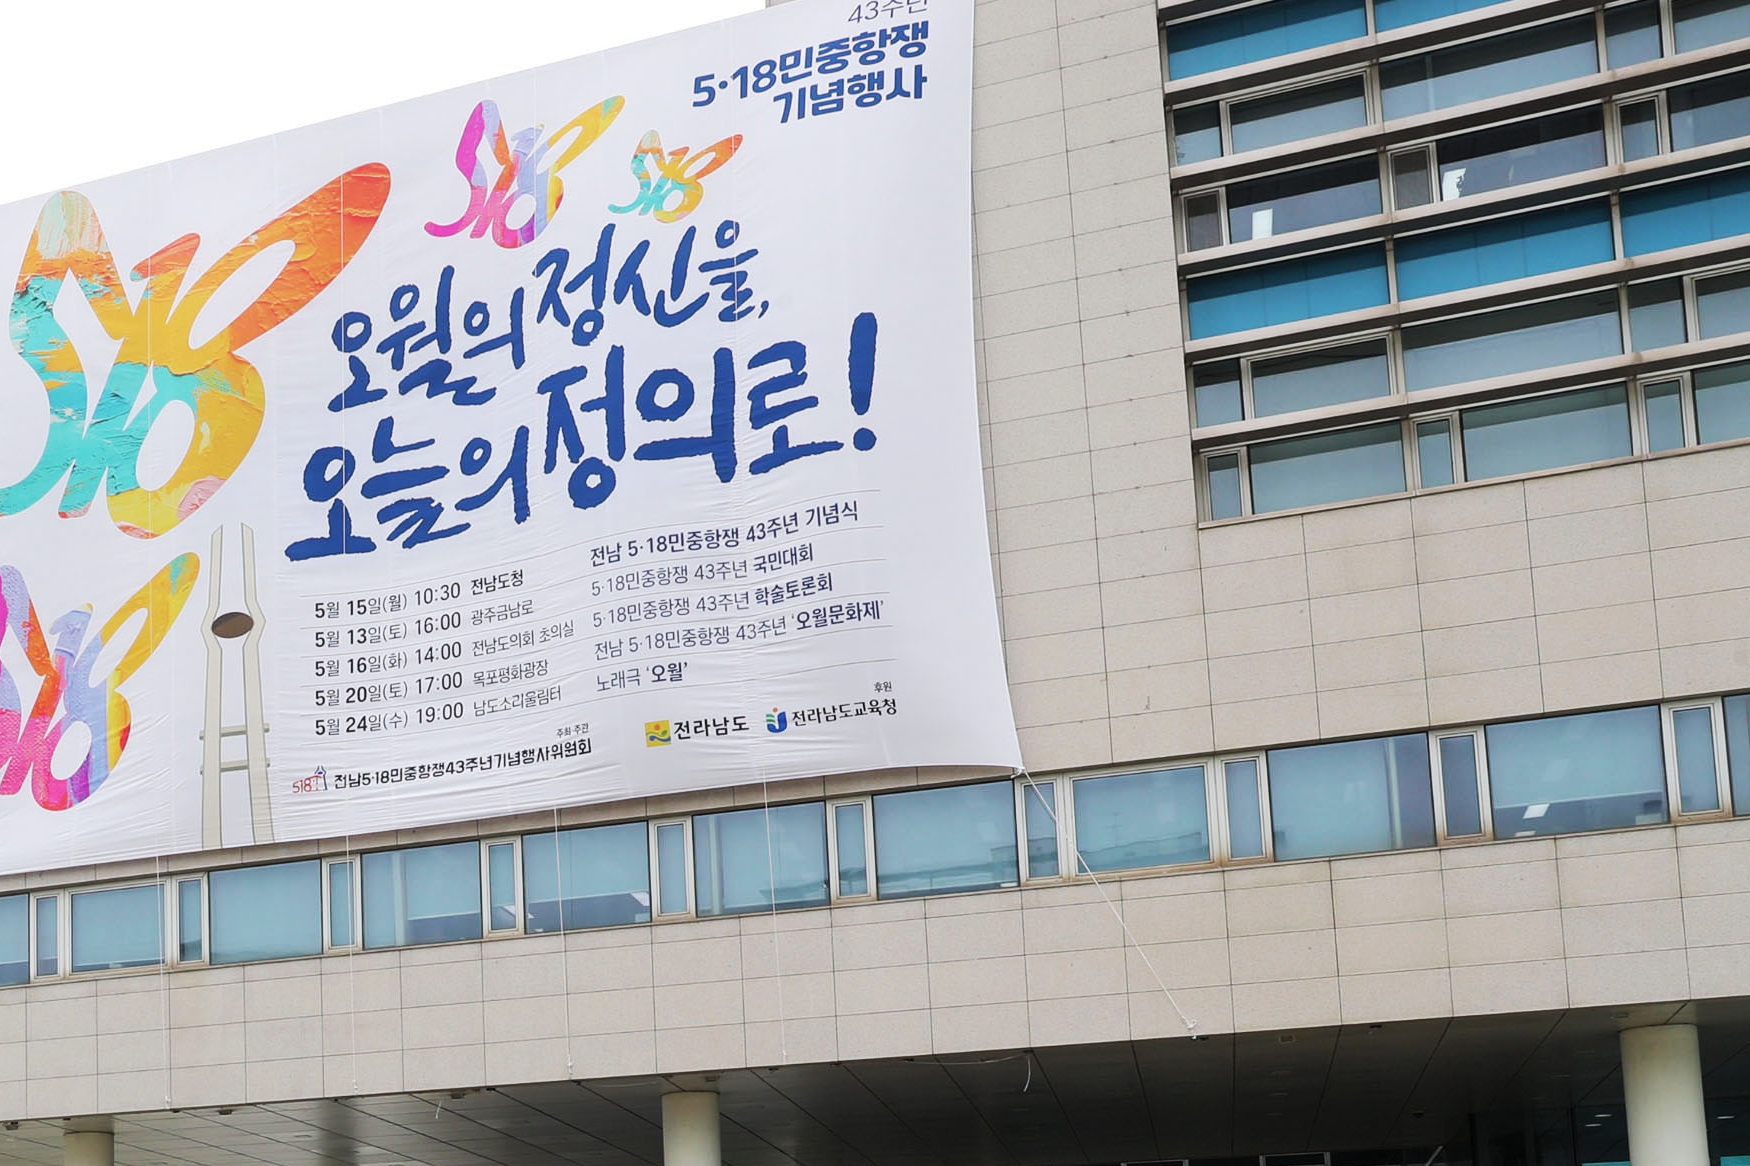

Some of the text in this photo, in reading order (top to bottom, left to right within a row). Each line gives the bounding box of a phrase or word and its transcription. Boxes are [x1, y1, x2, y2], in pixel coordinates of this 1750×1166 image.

[693, 20, 929, 107] 5·18민중항쟁
[773, 64, 928, 123] 기념행사
[328, 220, 769, 413] 오월의 정신을,
[284, 312, 878, 561] 오늘의 정의로!
[590, 500, 858, 567] 전남 5·18민중항쟁 43주년 기념식
[315, 569, 524, 619] 5월 15일(월) 10:30 전남도청
[591, 543, 814, 596] 5·18민중항쟁 43주년 국민대회
[315, 599, 534, 648] 5월 13일(토) 16:00 광주금남로
[593, 572, 833, 628] 5·18민중항쟁 43주년 학술토론회
[315, 620, 574, 677] 5월 16일(화) 14:00 전남도의회 초의실
[594, 638, 623, 662] 전남
[628, 625, 730, 653] 5·18민중항쟁
[736, 616, 787, 641] 43주년
[315, 659, 549, 707] 5월 20일(토) 17:00 목포평화광장
[596, 667, 641, 693] 노래극
[874, 680, 893, 694] 후원
[315, 685, 562, 736] 5월 24일(수) 19:00 남도소리울림터
[673, 715, 750, 741] 전라남도
[791, 698, 897, 728] 전라남도교육청
